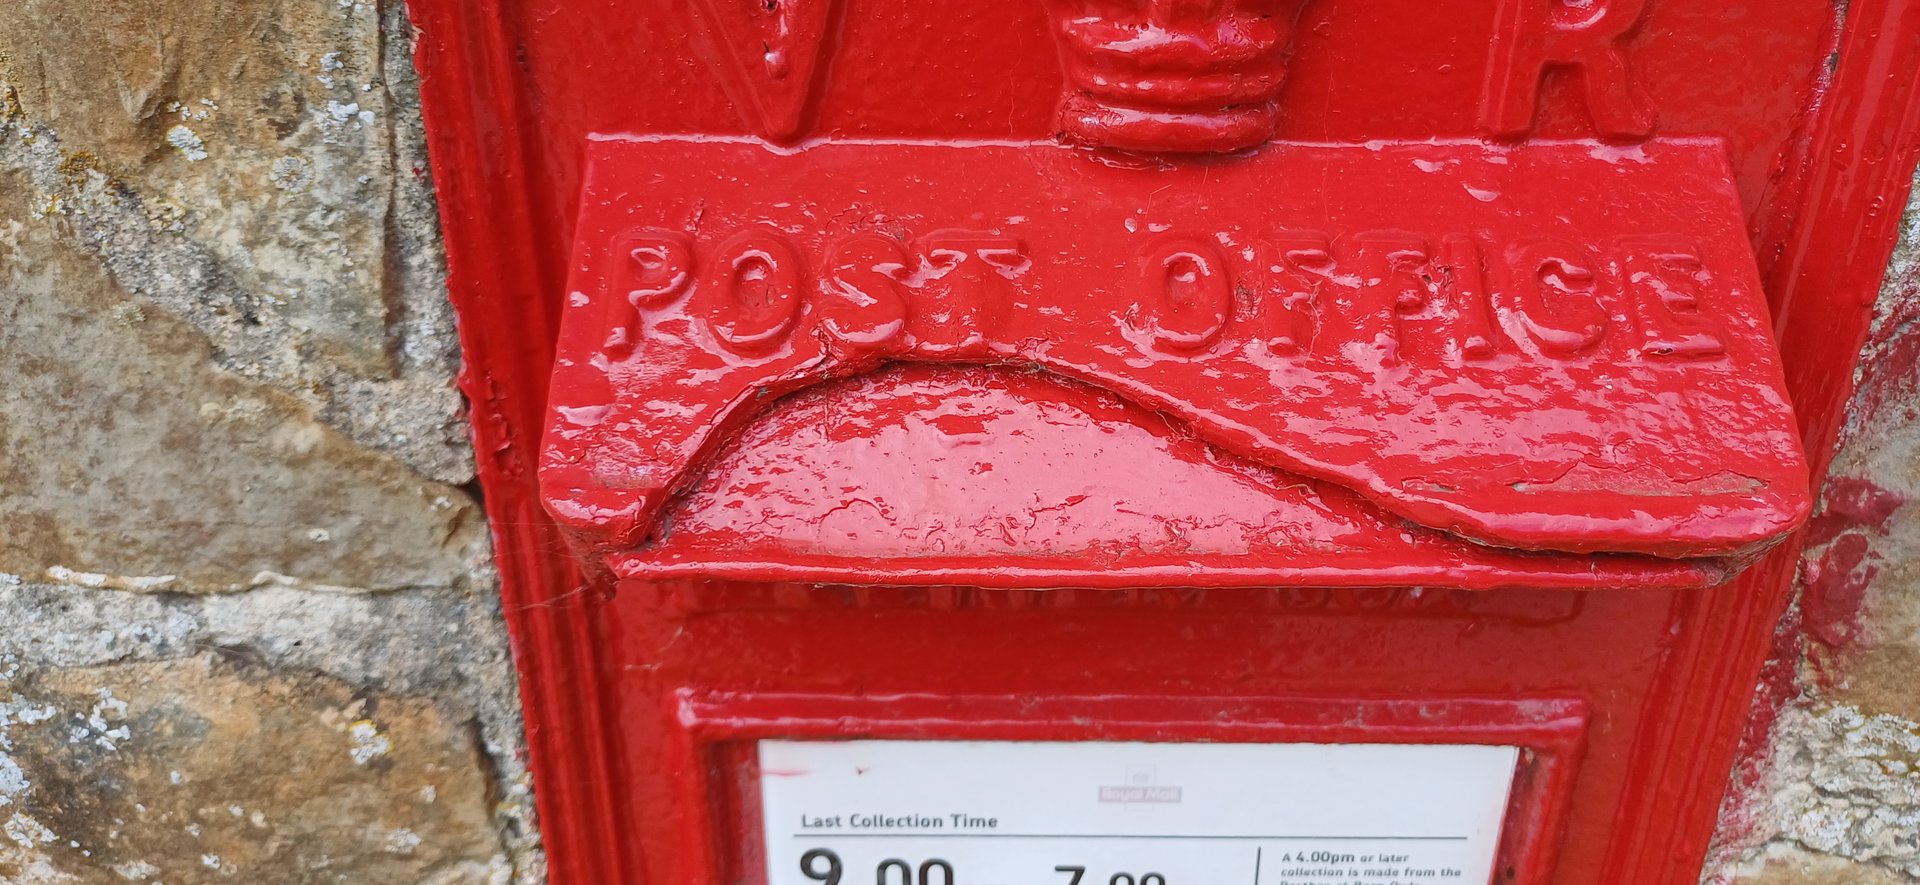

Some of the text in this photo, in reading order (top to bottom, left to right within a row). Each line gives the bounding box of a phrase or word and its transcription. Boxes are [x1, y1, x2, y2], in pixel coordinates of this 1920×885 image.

[603, 229, 1727, 361] POST OFFICE
[1101, 786, 1180, 802] Royal Mail
[801, 813, 998, 829] Last Collection Time
[1281, 851, 1409, 865] A 4.00pm or later
[799, 848, 955, 885] 900
[1280, 867, 1461, 877] collection is made from the
